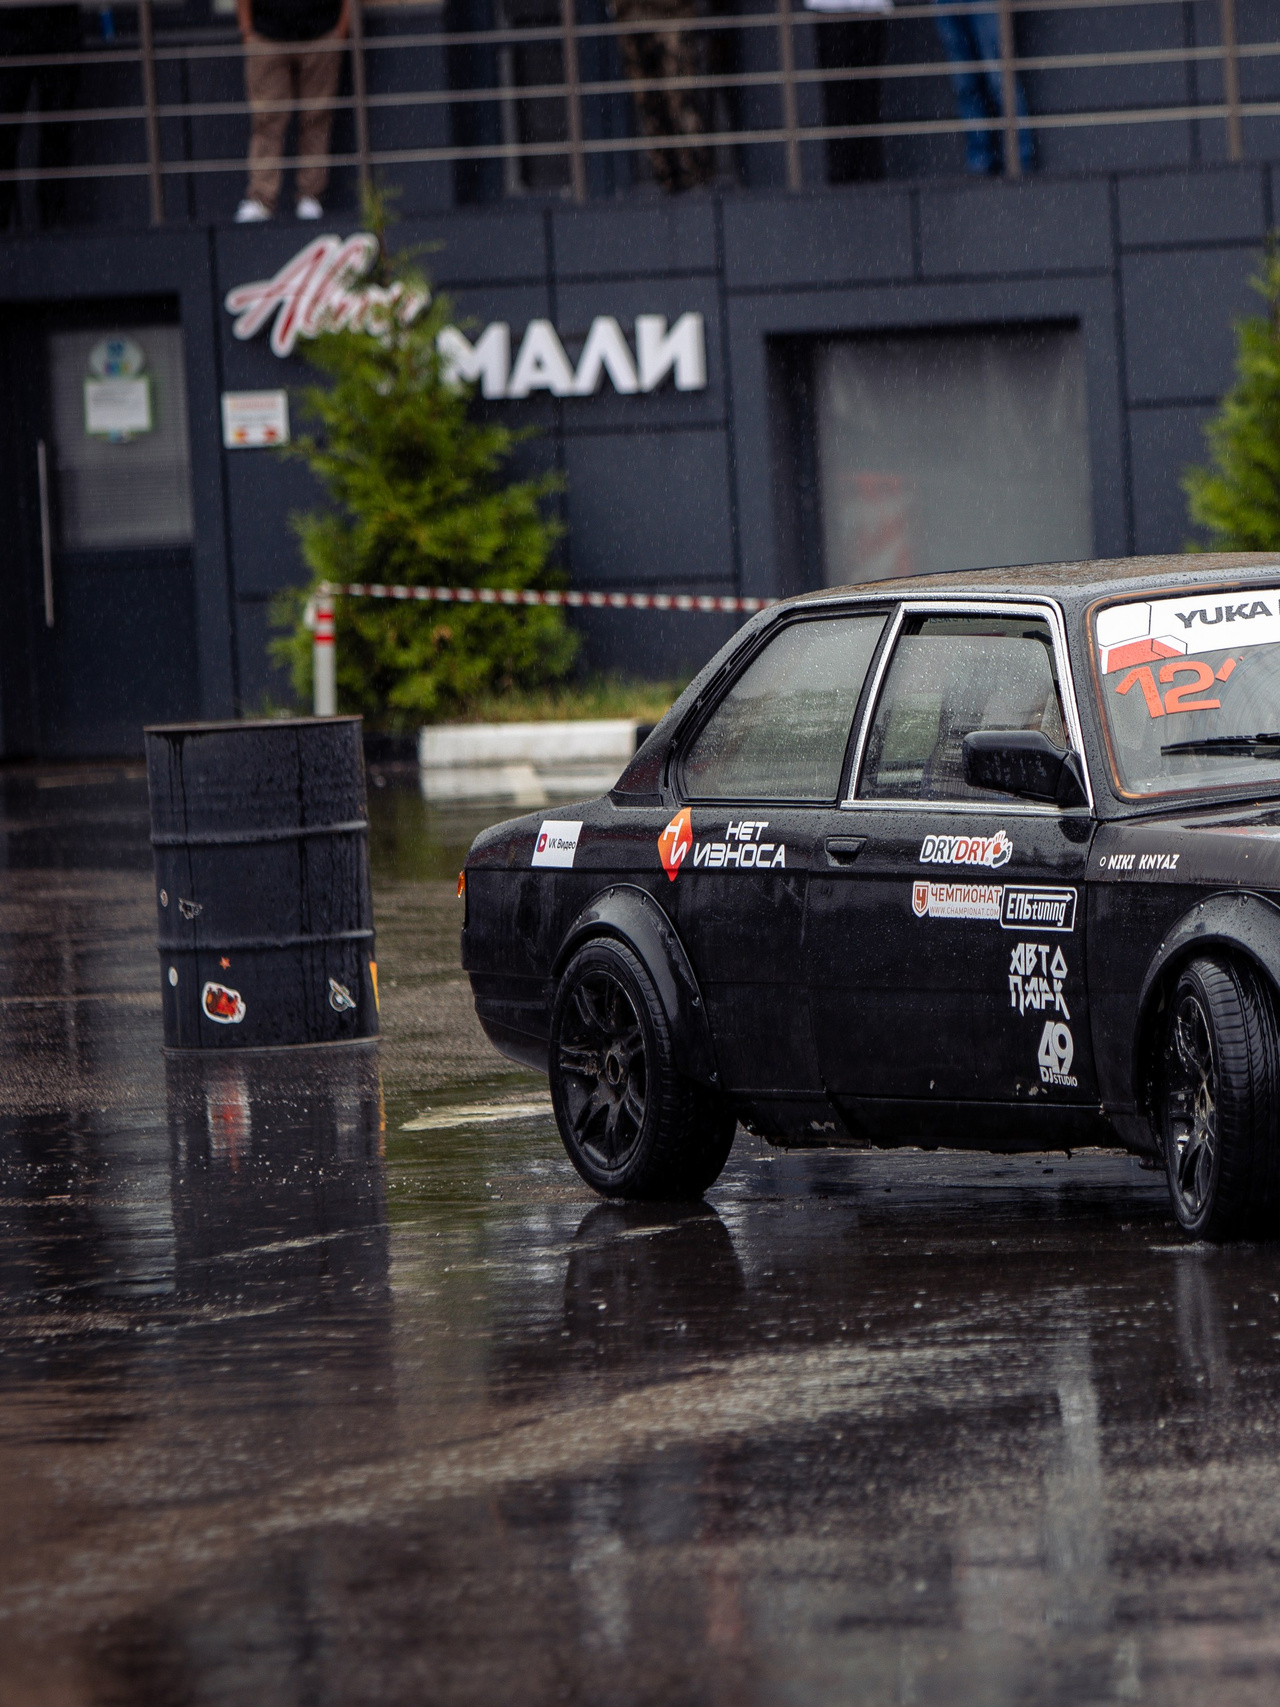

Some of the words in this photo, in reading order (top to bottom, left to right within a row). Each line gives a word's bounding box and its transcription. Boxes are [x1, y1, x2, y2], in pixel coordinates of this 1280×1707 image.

[1174, 602, 1272, 629] YUKA
[724, 820, 770, 842] НЕТ
[549, 838, 557, 849] VK
[557, 839, 577, 852] Видео
[693, 843, 787, 869] ИЗНОСА
[920, 836, 992, 862] DRYDRY
[1107, 854, 1136, 870] NIKI
[1138, 854, 1180, 870] KNYAZ
[931, 887, 1001, 904] ЧЕМПИОНАТ
[930, 906, 999, 917] WWW.CHAMPIONAT.COM
[1009, 943, 1068, 979] АВТО
[1008, 975, 1070, 1020] ПАРК
[1038, 1021, 1073, 1075] 49
[1040, 1066, 1054, 1083] DJ
[1053, 1074, 1078, 1087] STUDIO
